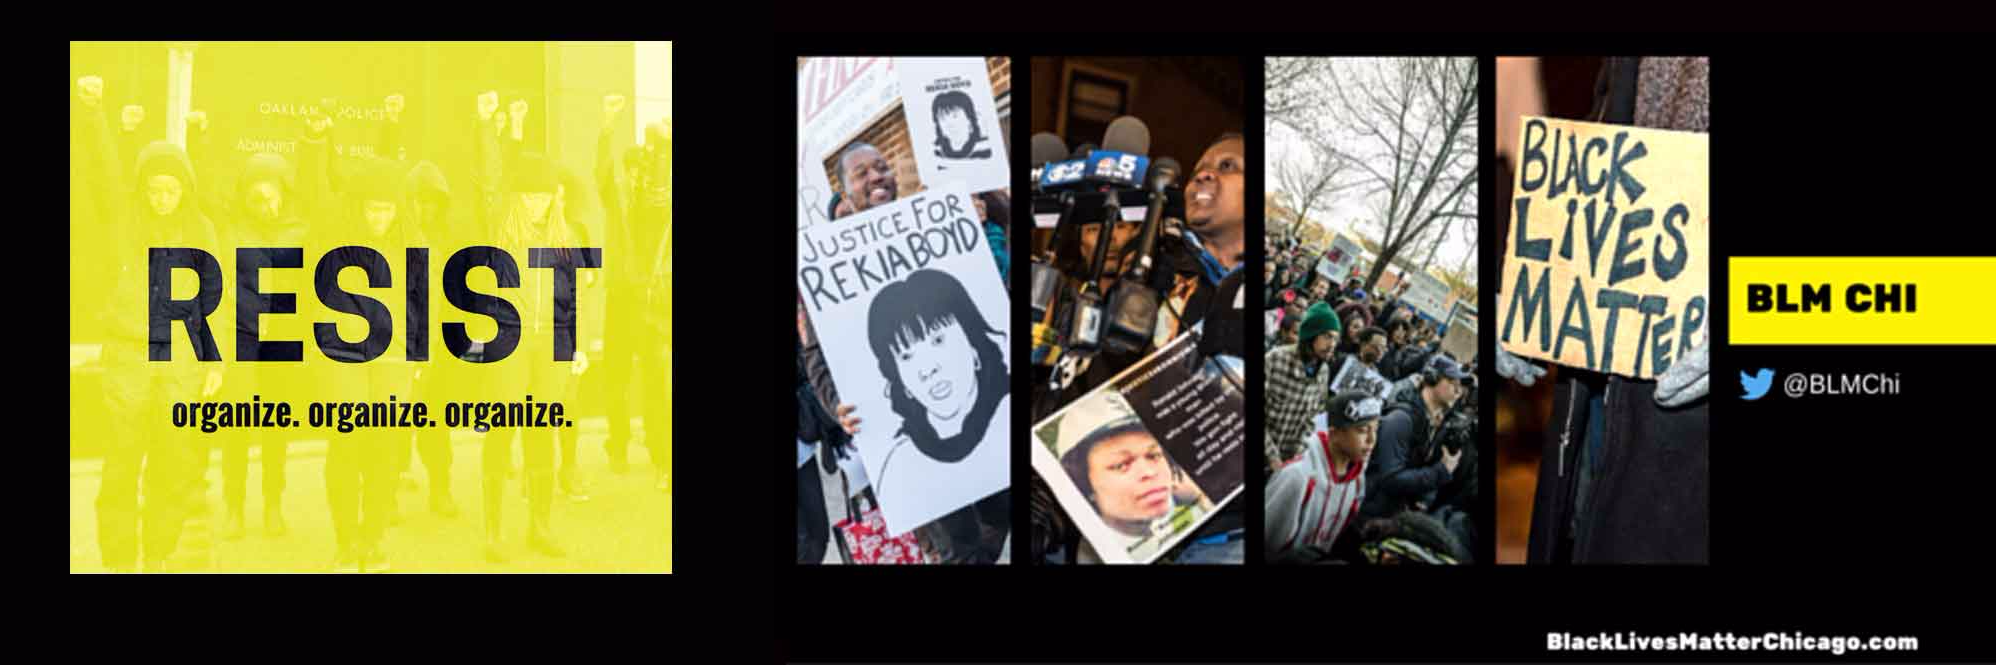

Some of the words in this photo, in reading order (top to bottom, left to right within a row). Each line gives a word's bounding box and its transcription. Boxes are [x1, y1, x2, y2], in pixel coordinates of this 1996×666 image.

[259, 102, 319, 116] OAKLAN
[1520, 119, 1648, 204] BLACK
[800, 245, 913, 312] REKIA
[906, 217, 979, 268] BOYD
[803, 212, 909, 263] JUSTICE
[911, 194, 964, 229] FOR
[1502, 263, 1706, 377] MATTER
